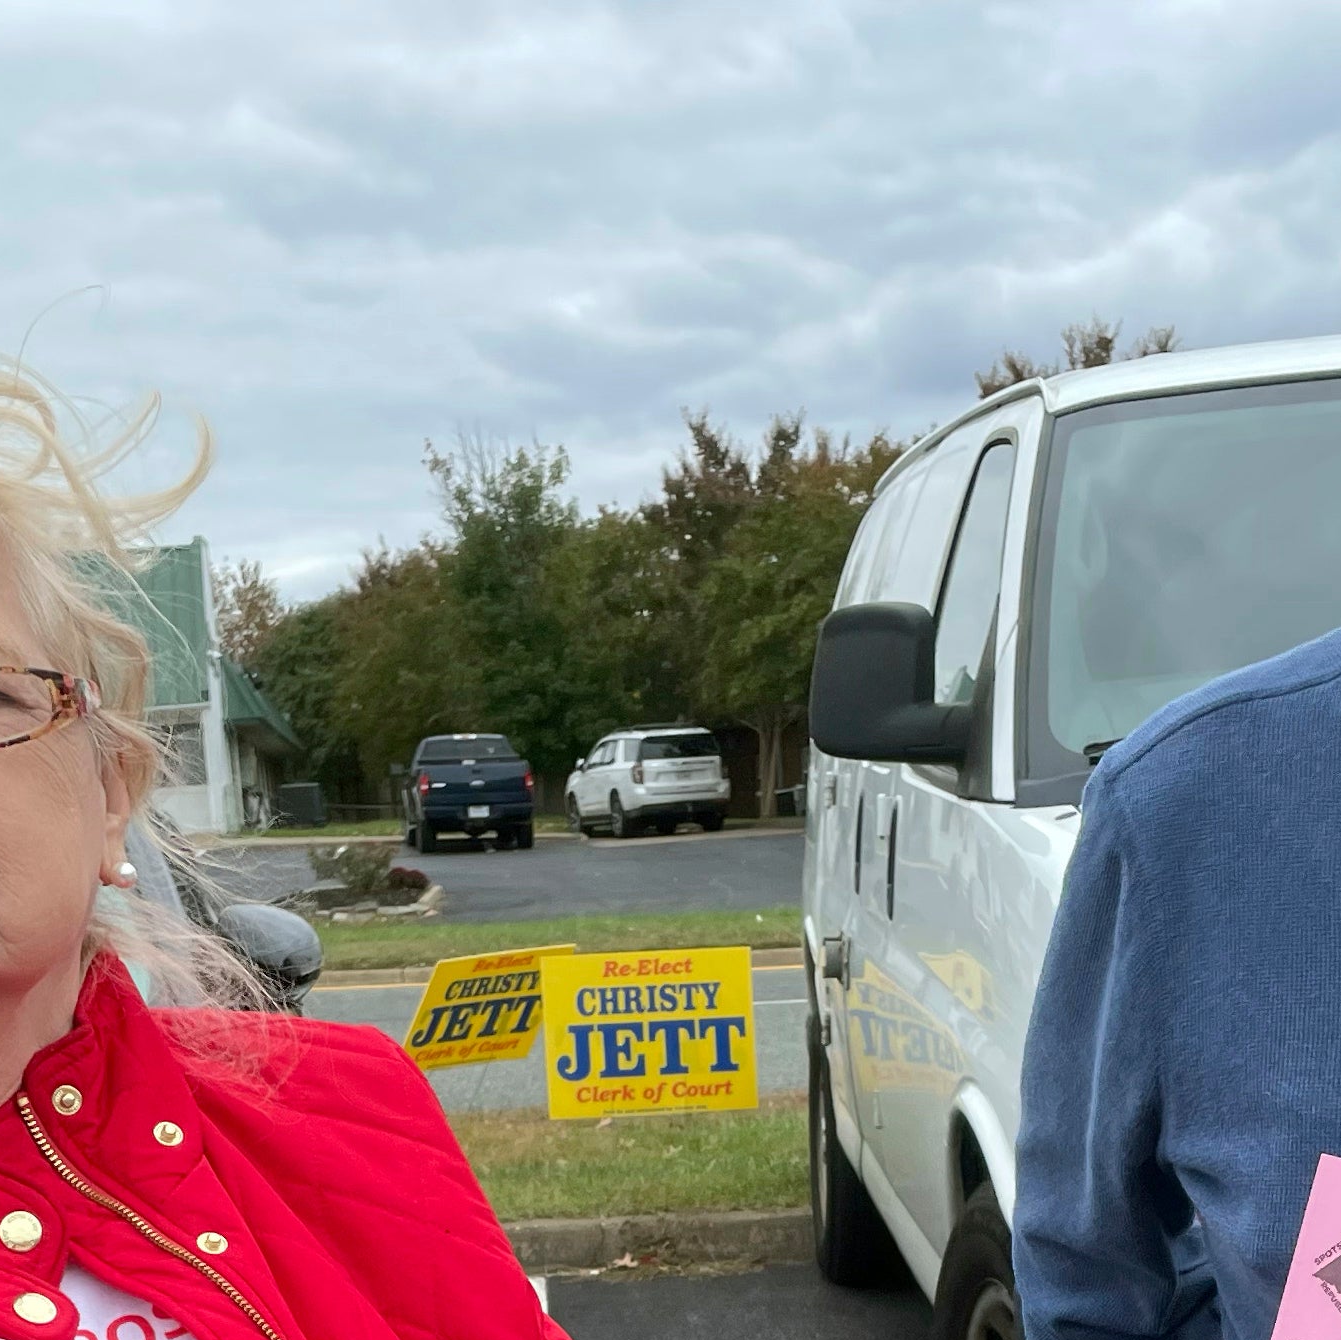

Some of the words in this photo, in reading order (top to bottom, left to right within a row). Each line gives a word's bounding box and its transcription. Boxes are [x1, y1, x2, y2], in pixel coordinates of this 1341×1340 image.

[472, 954, 534, 972] Re-Elect
[603, 957, 693, 978] Re-Elect
[445, 970, 541, 1001] CHRISTY
[576, 982, 720, 1017] CHRISTY
[411, 995, 541, 1048] JETT
[415, 1047, 453, 1062] Clerk
[459, 1044, 474, 1058] of
[479, 1038, 520, 1054] Court
[557, 1017, 746, 1081] JETT
[576, 1085, 633, 1102] Clerk
[642, 1083, 666, 1104] of
[672, 1080, 733, 1098] Court
